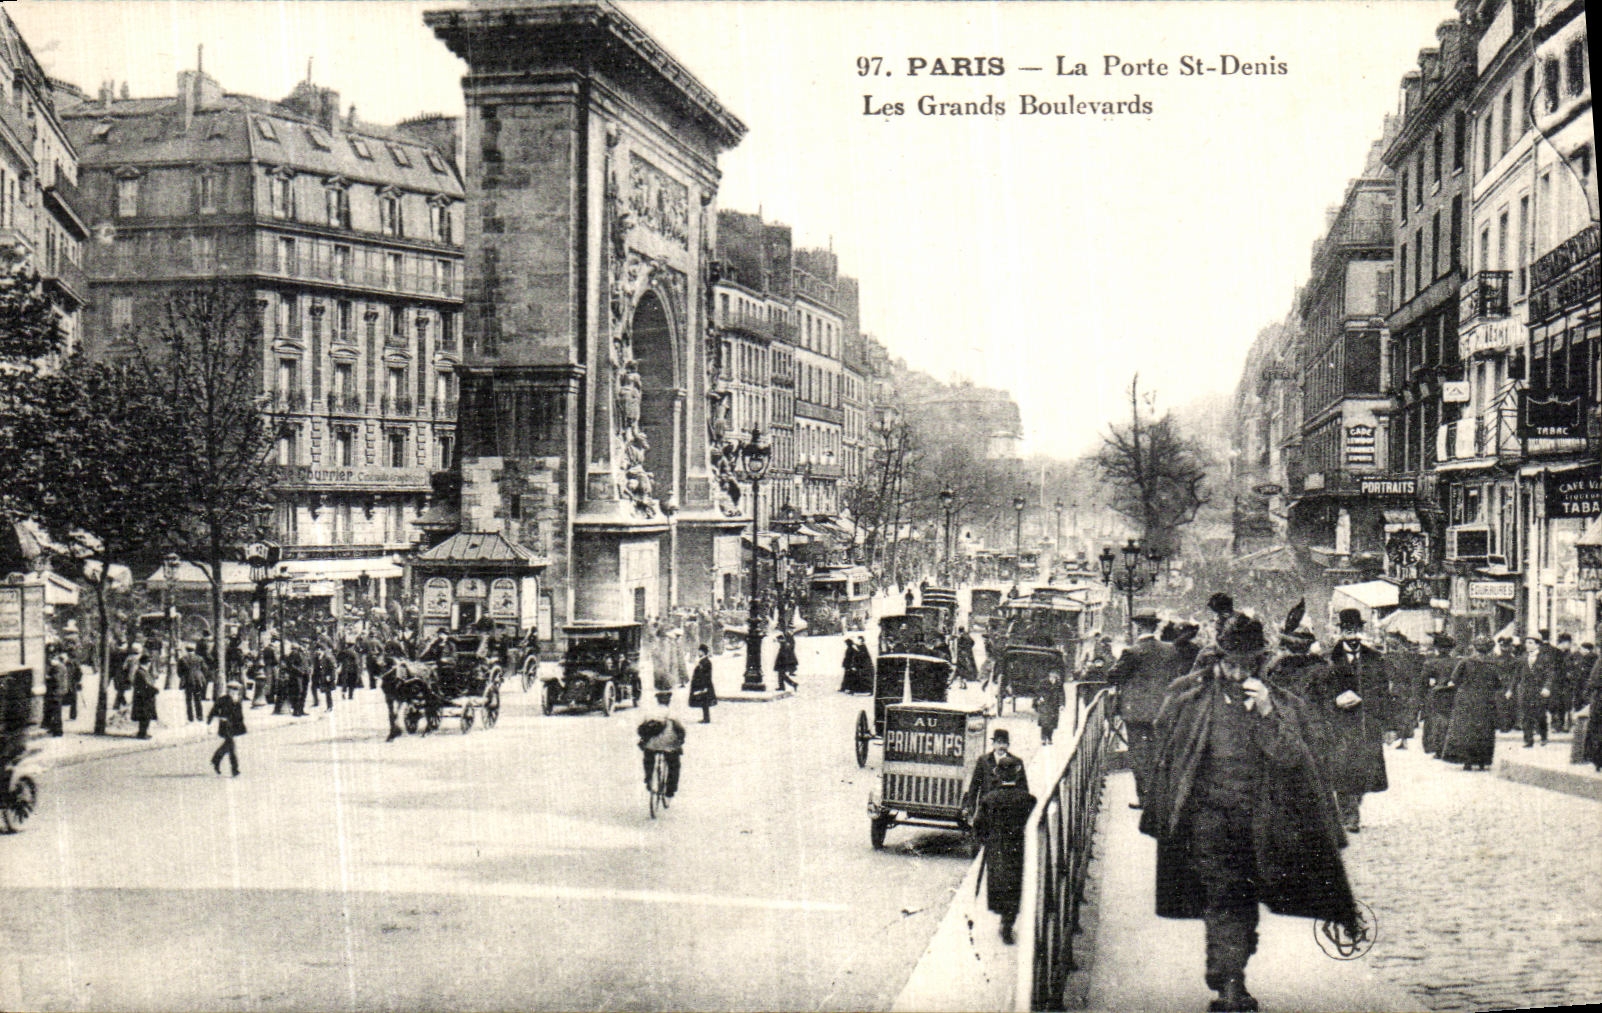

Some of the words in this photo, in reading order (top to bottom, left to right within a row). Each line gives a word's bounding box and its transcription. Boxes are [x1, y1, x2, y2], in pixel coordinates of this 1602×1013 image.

[1536, 427, 1569, 435] TABAC
[1361, 481, 1414, 494] PORTRAITS
[914, 717, 938, 727] AU
[886, 730, 963, 757] PRINTEMPS
